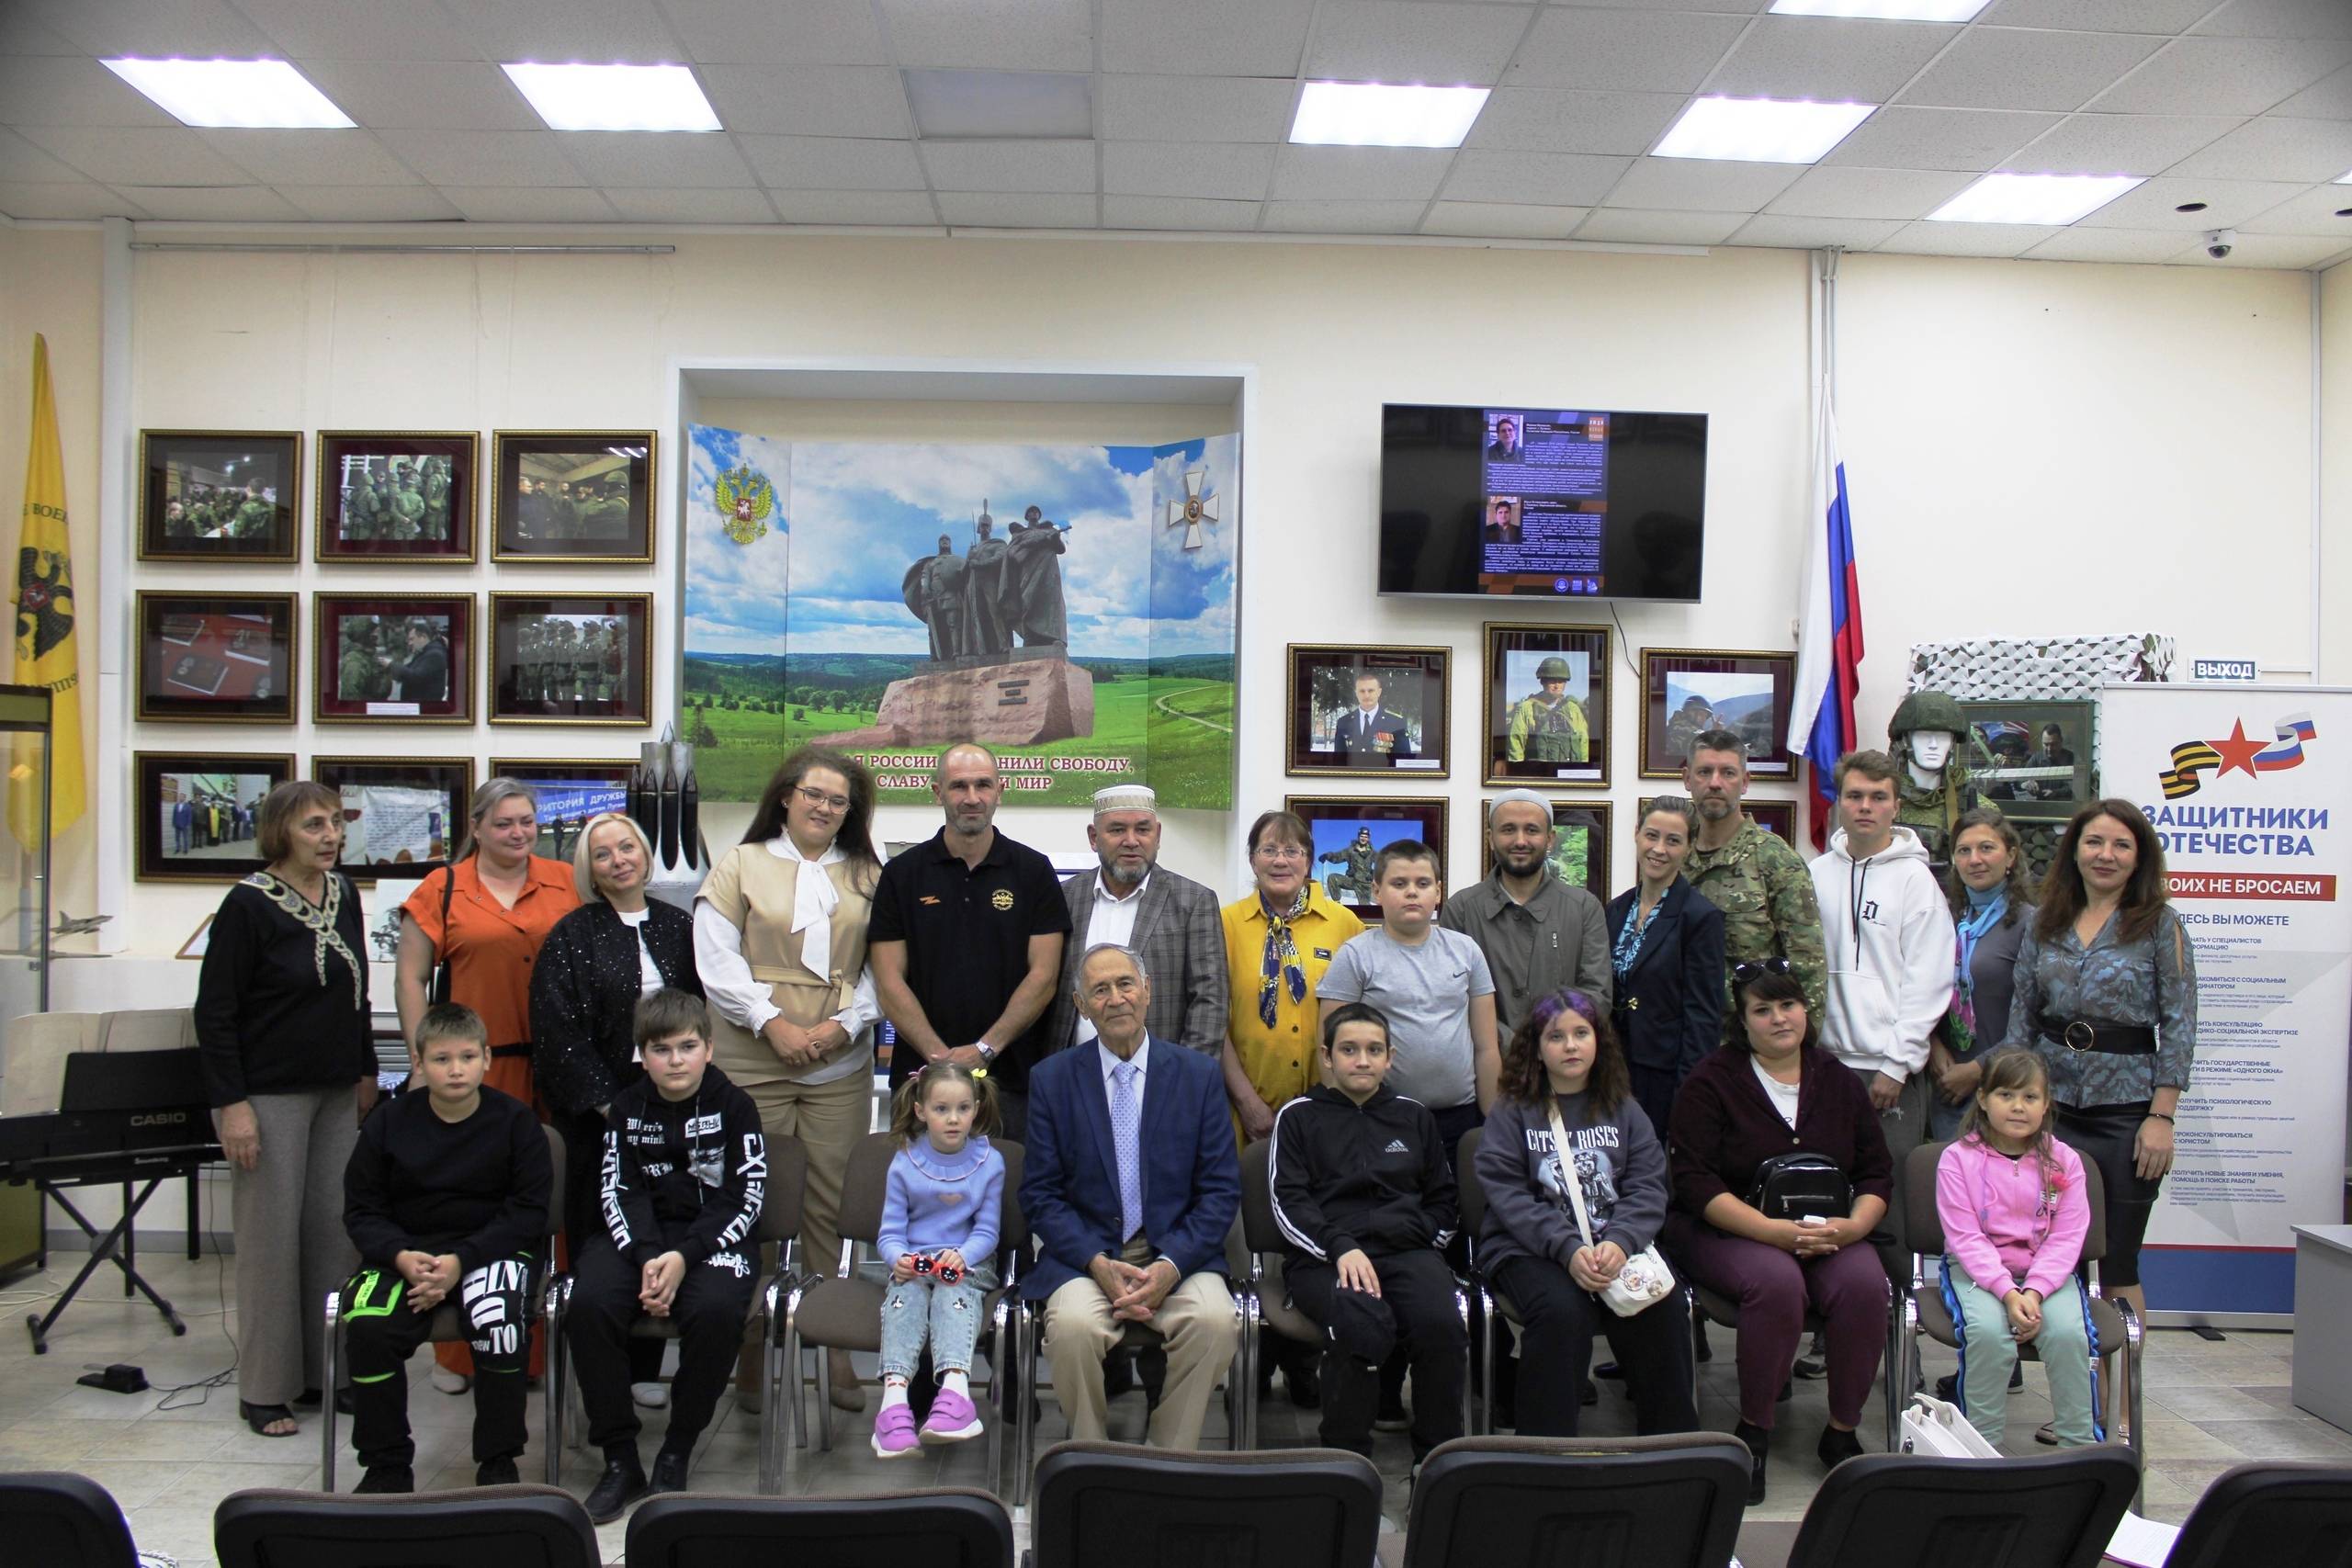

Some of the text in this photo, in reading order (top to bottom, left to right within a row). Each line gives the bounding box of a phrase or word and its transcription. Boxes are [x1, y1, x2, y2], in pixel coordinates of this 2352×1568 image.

[2197, 662, 2253, 678] ВЫХОД
[870, 755, 937, 768] РОССИИ
[998, 757, 1045, 770] НИЛИ
[1051, 758, 1135, 773] СВОБОДУ,
[1016, 777, 1053, 790] МИР
[537, 796, 585, 813] РИТОРИЯ
[2142, 805, 2328, 830] ЗАЩИТНИКИ
[2156, 832, 2315, 856] ОТЕЧЕСТВА
[2161, 877, 2321, 895] ОИХ НЕ БРОСАЕМ
[2179, 914, 2290, 926] ДЕСЬ ВЫ МОЖЕТЕ
[130, 1112, 187, 1127] CASIO
[1577, 1125, 1620, 1150] ROSES
